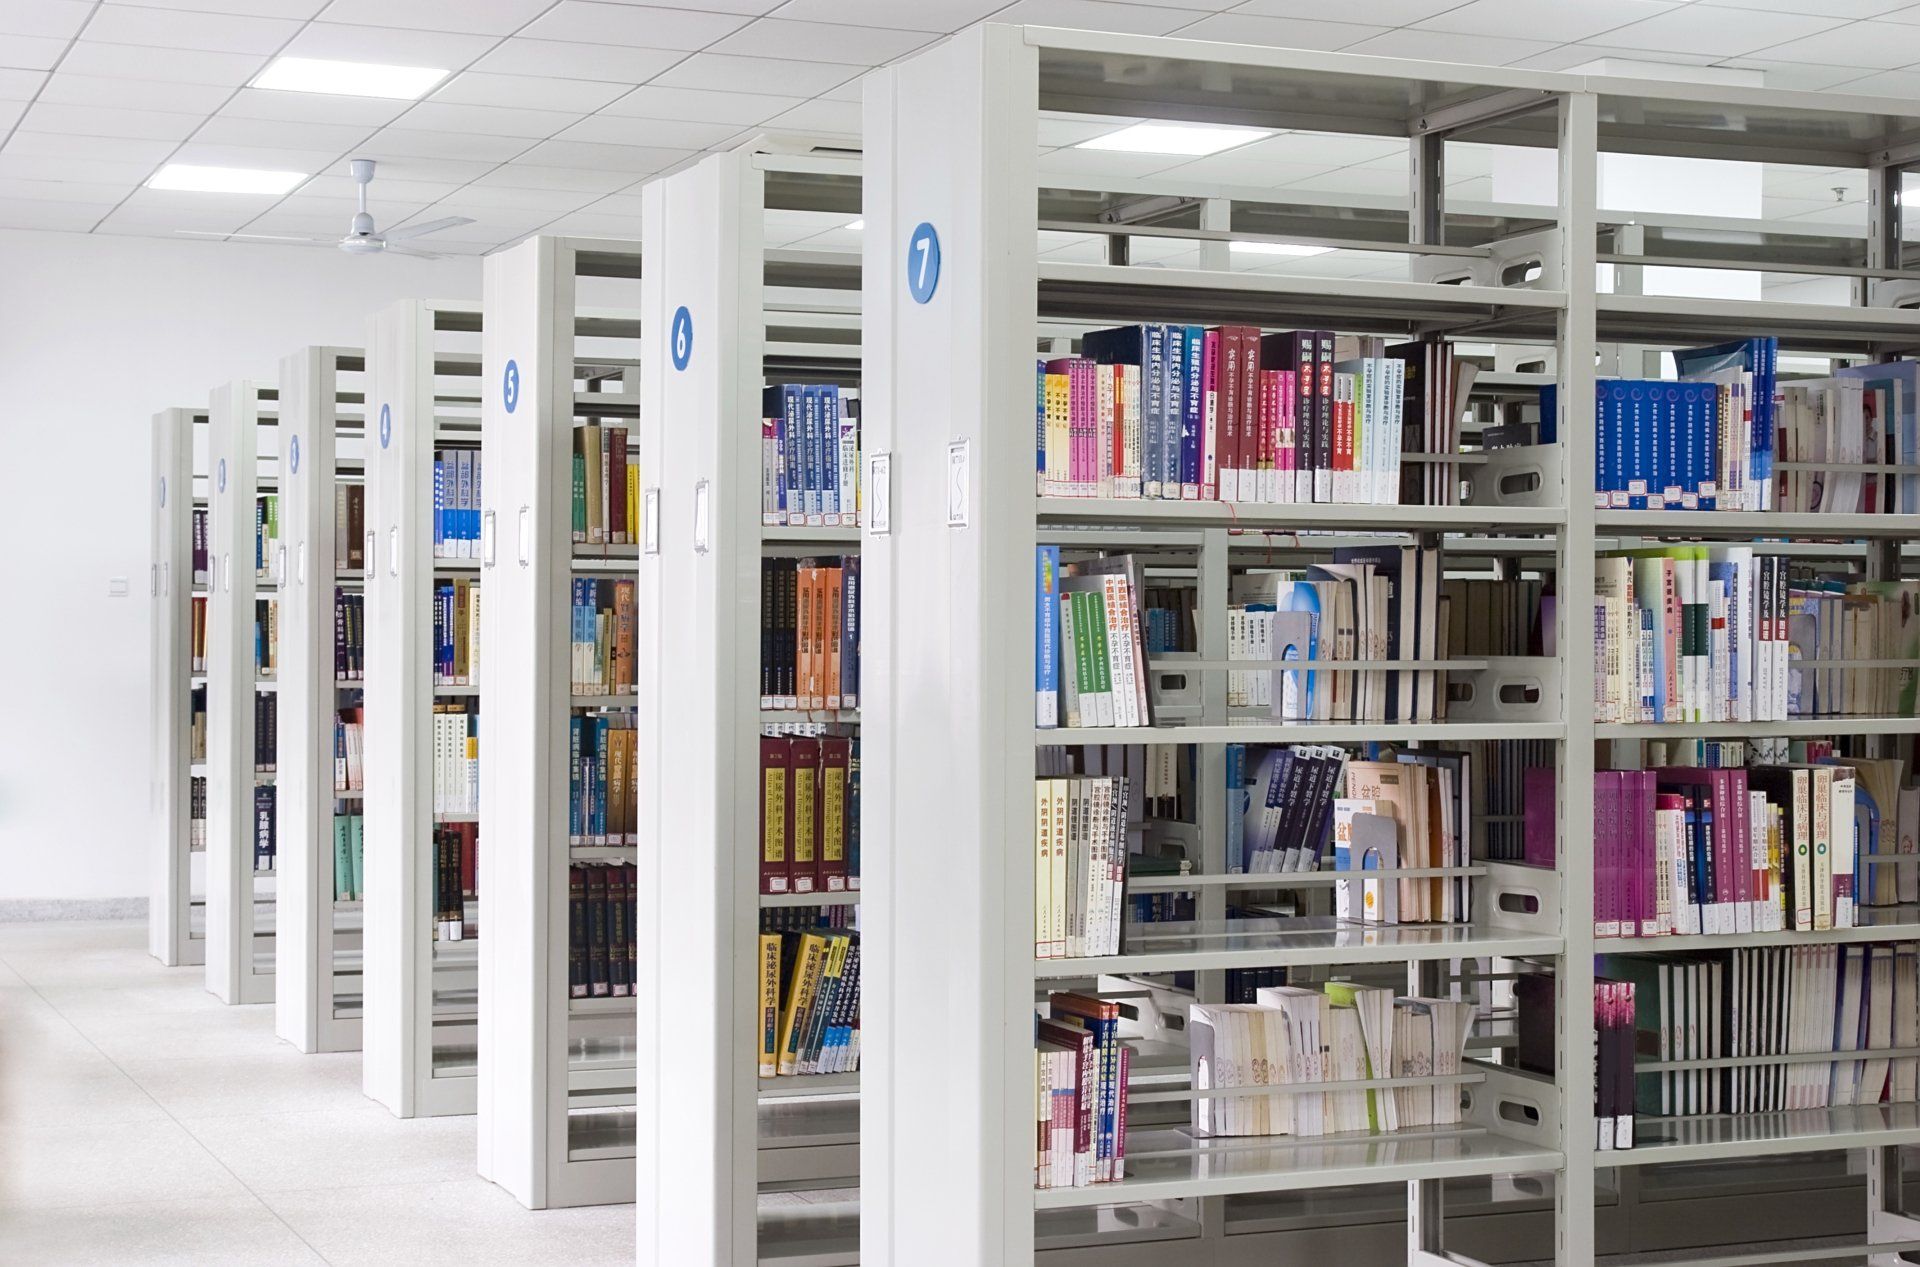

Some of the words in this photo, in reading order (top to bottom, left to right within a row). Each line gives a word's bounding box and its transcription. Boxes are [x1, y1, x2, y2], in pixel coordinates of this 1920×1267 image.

[917, 238, 928, 289] 7
[676, 317, 685, 359] 6
[507, 369, 514, 403] 5
[1150, 332, 1162, 415] 临床生殖内分泌与不育症
[1170, 332, 1182, 415] 临床生殖内分泌与不育症
[1106, 579, 1120, 670] 中西医结合治疗不孕不育症
[1118, 579, 1132, 670] 中西医结合治疗不孕不育症
[775, 772, 783, 858] 泌尿外科手术图谱
[834, 772, 842, 858] 泌尿外科手术图谱
[1288, 766, 1303, 806] 尿道下裂学
[1303, 766, 1319, 806] 尿道下裂学
[1320, 766, 1336, 806] 尿道下裂学
[1796, 776, 1808, 841] 卵巢临床与病理
[1816, 774, 1828, 840] 卵巢临床与病理
[259, 811, 270, 849] 乳腺病学
[1056, 797, 1064, 857] 外阴阴道疾病
[1091, 786, 1101, 861] 宫腔镜诊断与手术图谱
[1101, 785, 1110, 860] 宫腔镜诊断与手术图谱
[766, 943, 777, 1006] 临床泌尿外科学
[799, 944, 819, 1006] 临床泌尿外科学
[1100, 1022, 1110, 1115] 子宫内膜异位症现代治疗
[1108, 1022, 1118, 1115] 子宫内膜异位症现代治疗
